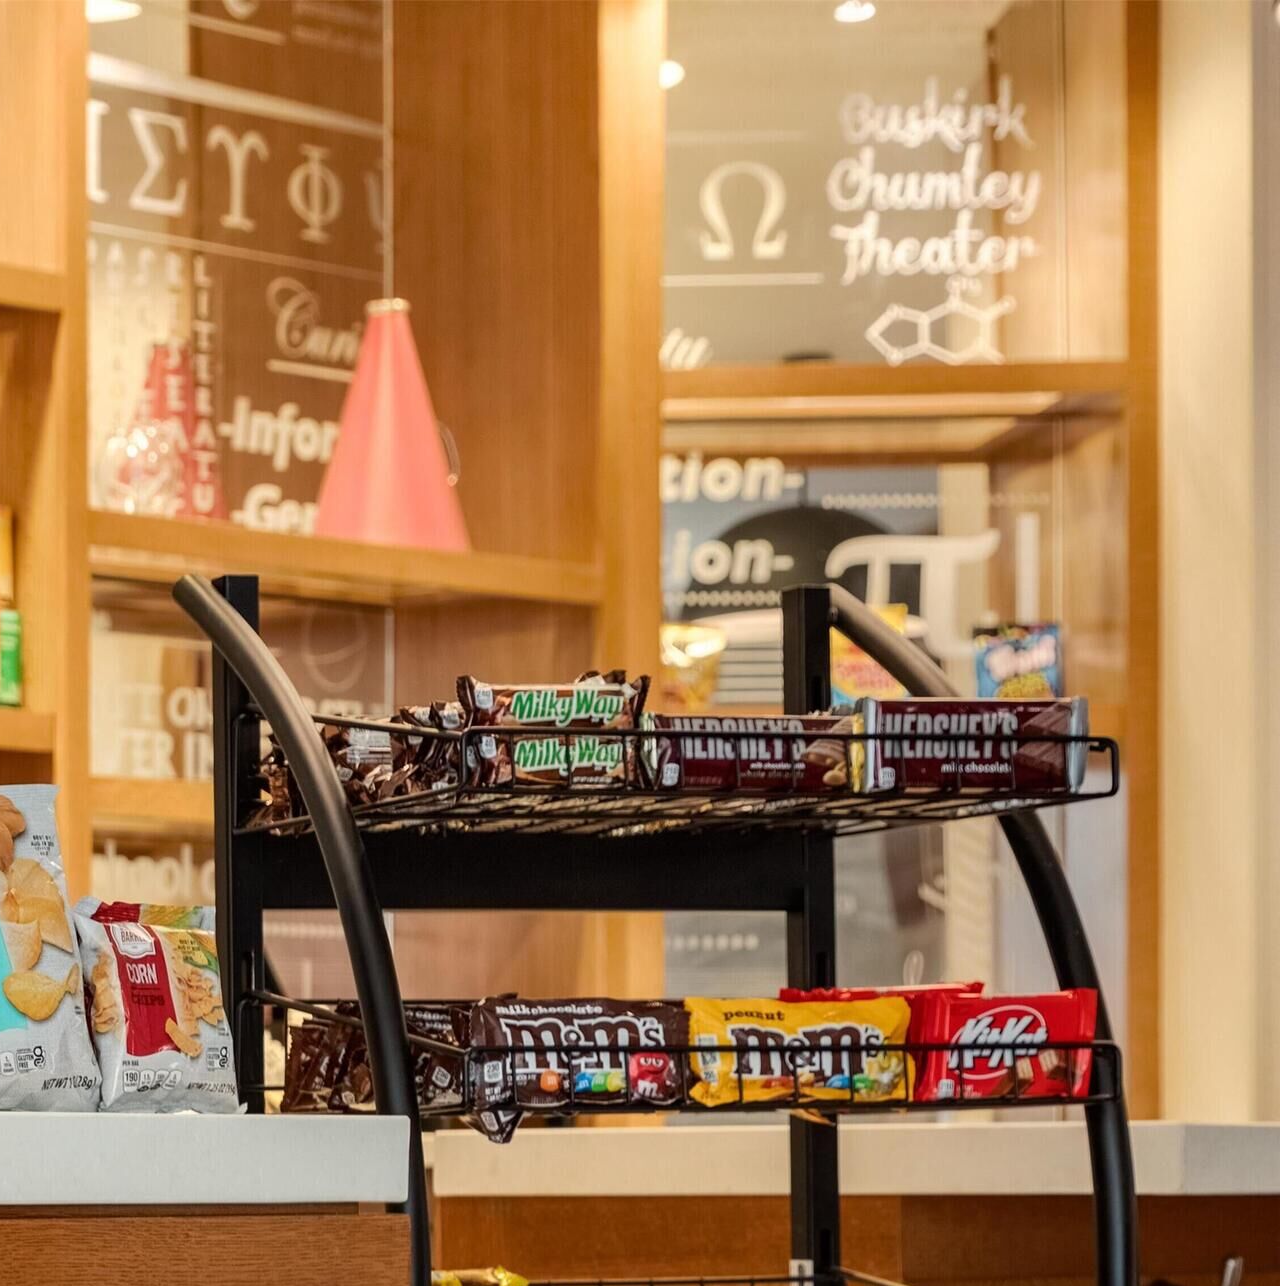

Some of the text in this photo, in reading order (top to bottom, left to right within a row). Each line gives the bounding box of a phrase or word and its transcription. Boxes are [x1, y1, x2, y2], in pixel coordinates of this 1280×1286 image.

[826, 142, 1042, 224] Chumley
[830, 210, 1040, 286] Theater
[511, 688, 624, 727] Milky Way
[126, 963, 158, 985] CORN
[496, 1004, 528, 1016] milk
[722, 1009, 785, 1023] peanut
[125, 1072, 139, 1083] 190
